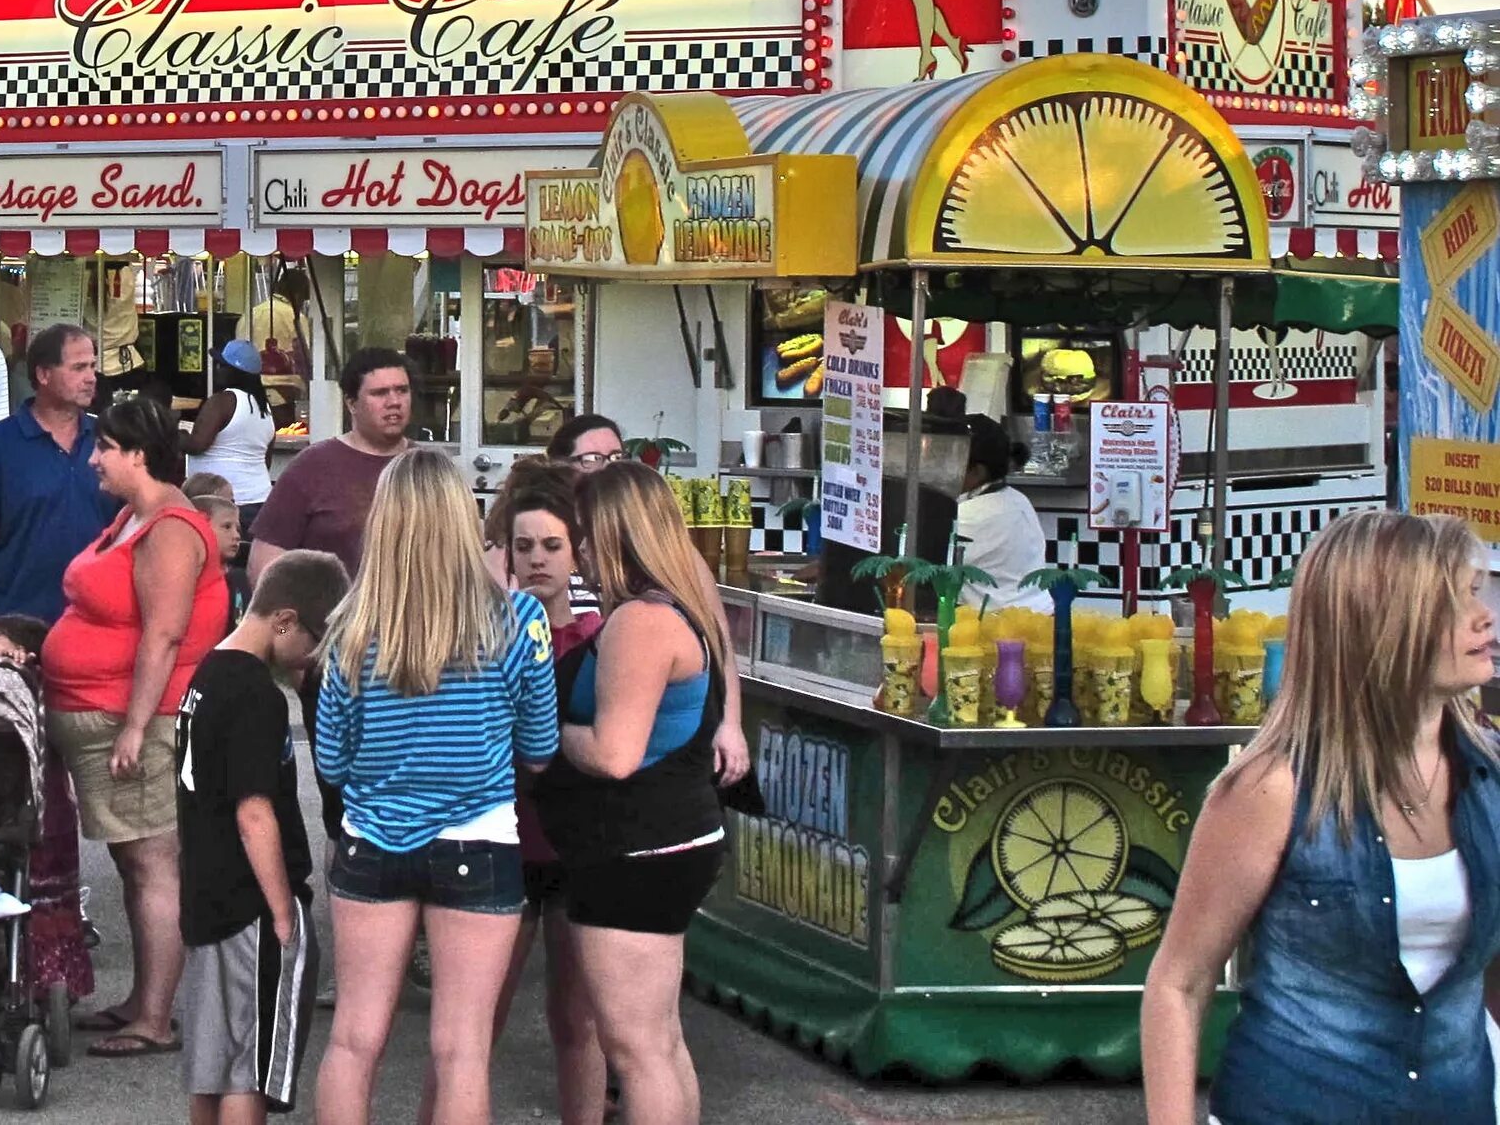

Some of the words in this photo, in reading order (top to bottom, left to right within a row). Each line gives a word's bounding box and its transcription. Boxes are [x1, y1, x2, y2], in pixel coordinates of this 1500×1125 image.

[635, 106, 676, 202] Classic
[92, 162, 203, 209] Sand.
[264, 178, 308, 212] Chili
[321, 158, 406, 207] Hot
[416, 159, 525, 220] Dogs
[539, 179, 600, 224] LEMON
[686, 175, 755, 219] FROZEN
[530, 226, 612, 262] SHAKE-UPS
[674, 219, 772, 263] LEMONADE
[1442, 204, 1478, 259] RIDE
[826, 355, 847, 373] COLD
[848, 358, 879, 379] DRINKS
[1437, 317, 1486, 386] TICKETS
[1100, 404, 1156, 418] Clair's
[1444, 452, 1480, 469] INSERT
[1425, 476, 1442, 492] $20
[1444, 478, 1471, 495] BILLS
[1474, 481, 1500, 498] ONLY
[1415, 501, 1426, 515] 16
[1428, 503, 1468, 518] TICKETS
[1471, 507, 1491, 524] FOR
[756, 720, 849, 839] FROZEN
[933, 745, 1050, 834] Clair's
[1068, 743, 1192, 835] Classic
[735, 812, 870, 949] LEMONADE
